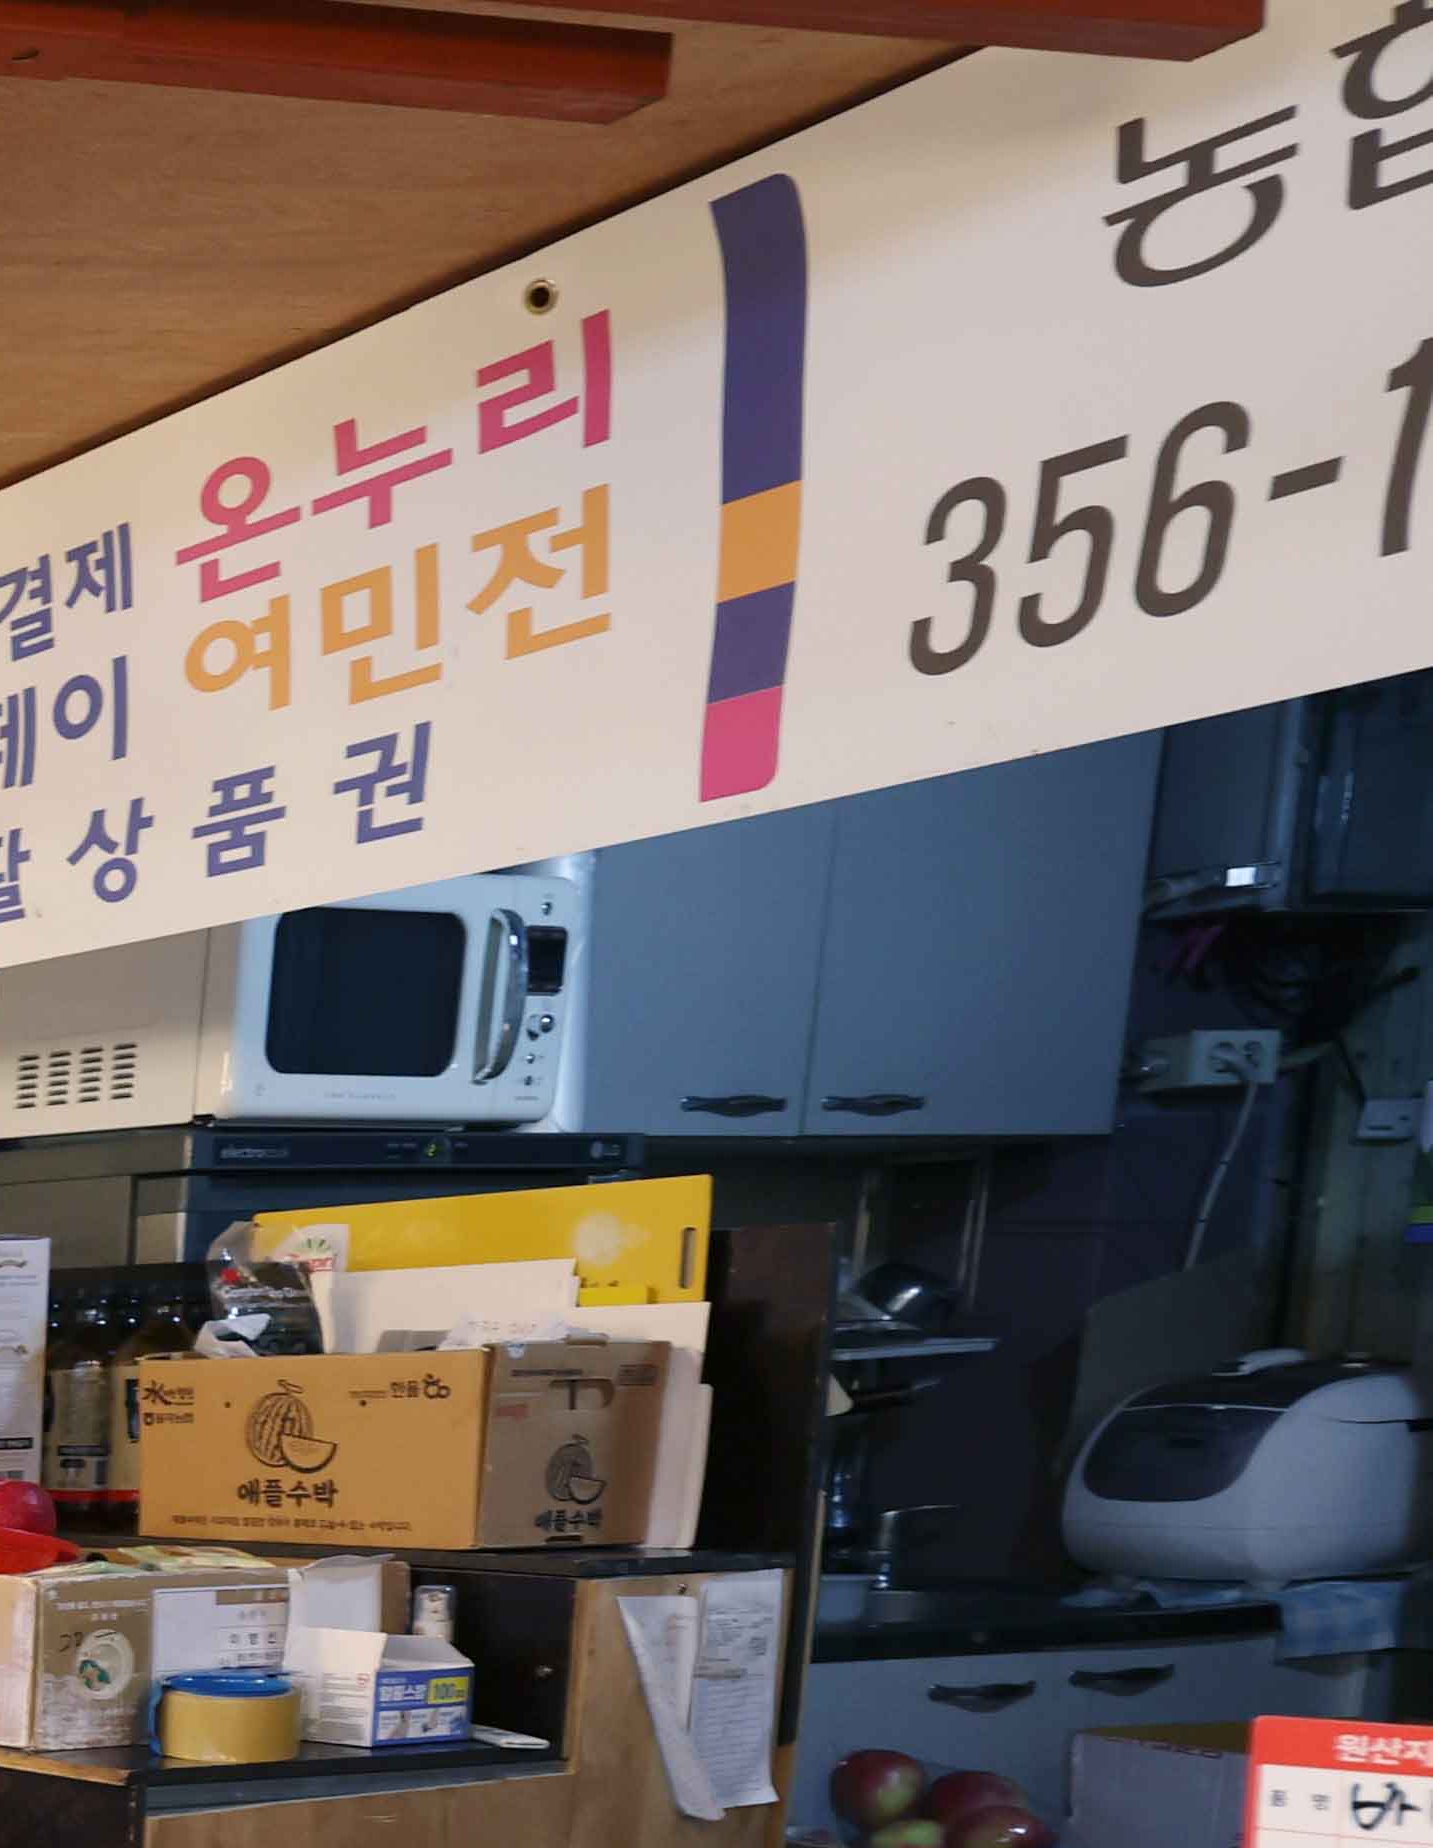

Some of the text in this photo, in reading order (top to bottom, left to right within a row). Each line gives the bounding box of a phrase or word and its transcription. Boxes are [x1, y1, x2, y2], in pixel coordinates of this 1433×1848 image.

[176, 309, 610, 603] 온누리
[184, 483, 611, 711] 여민전
[236, 1478, 339, 1508] 애플수박
